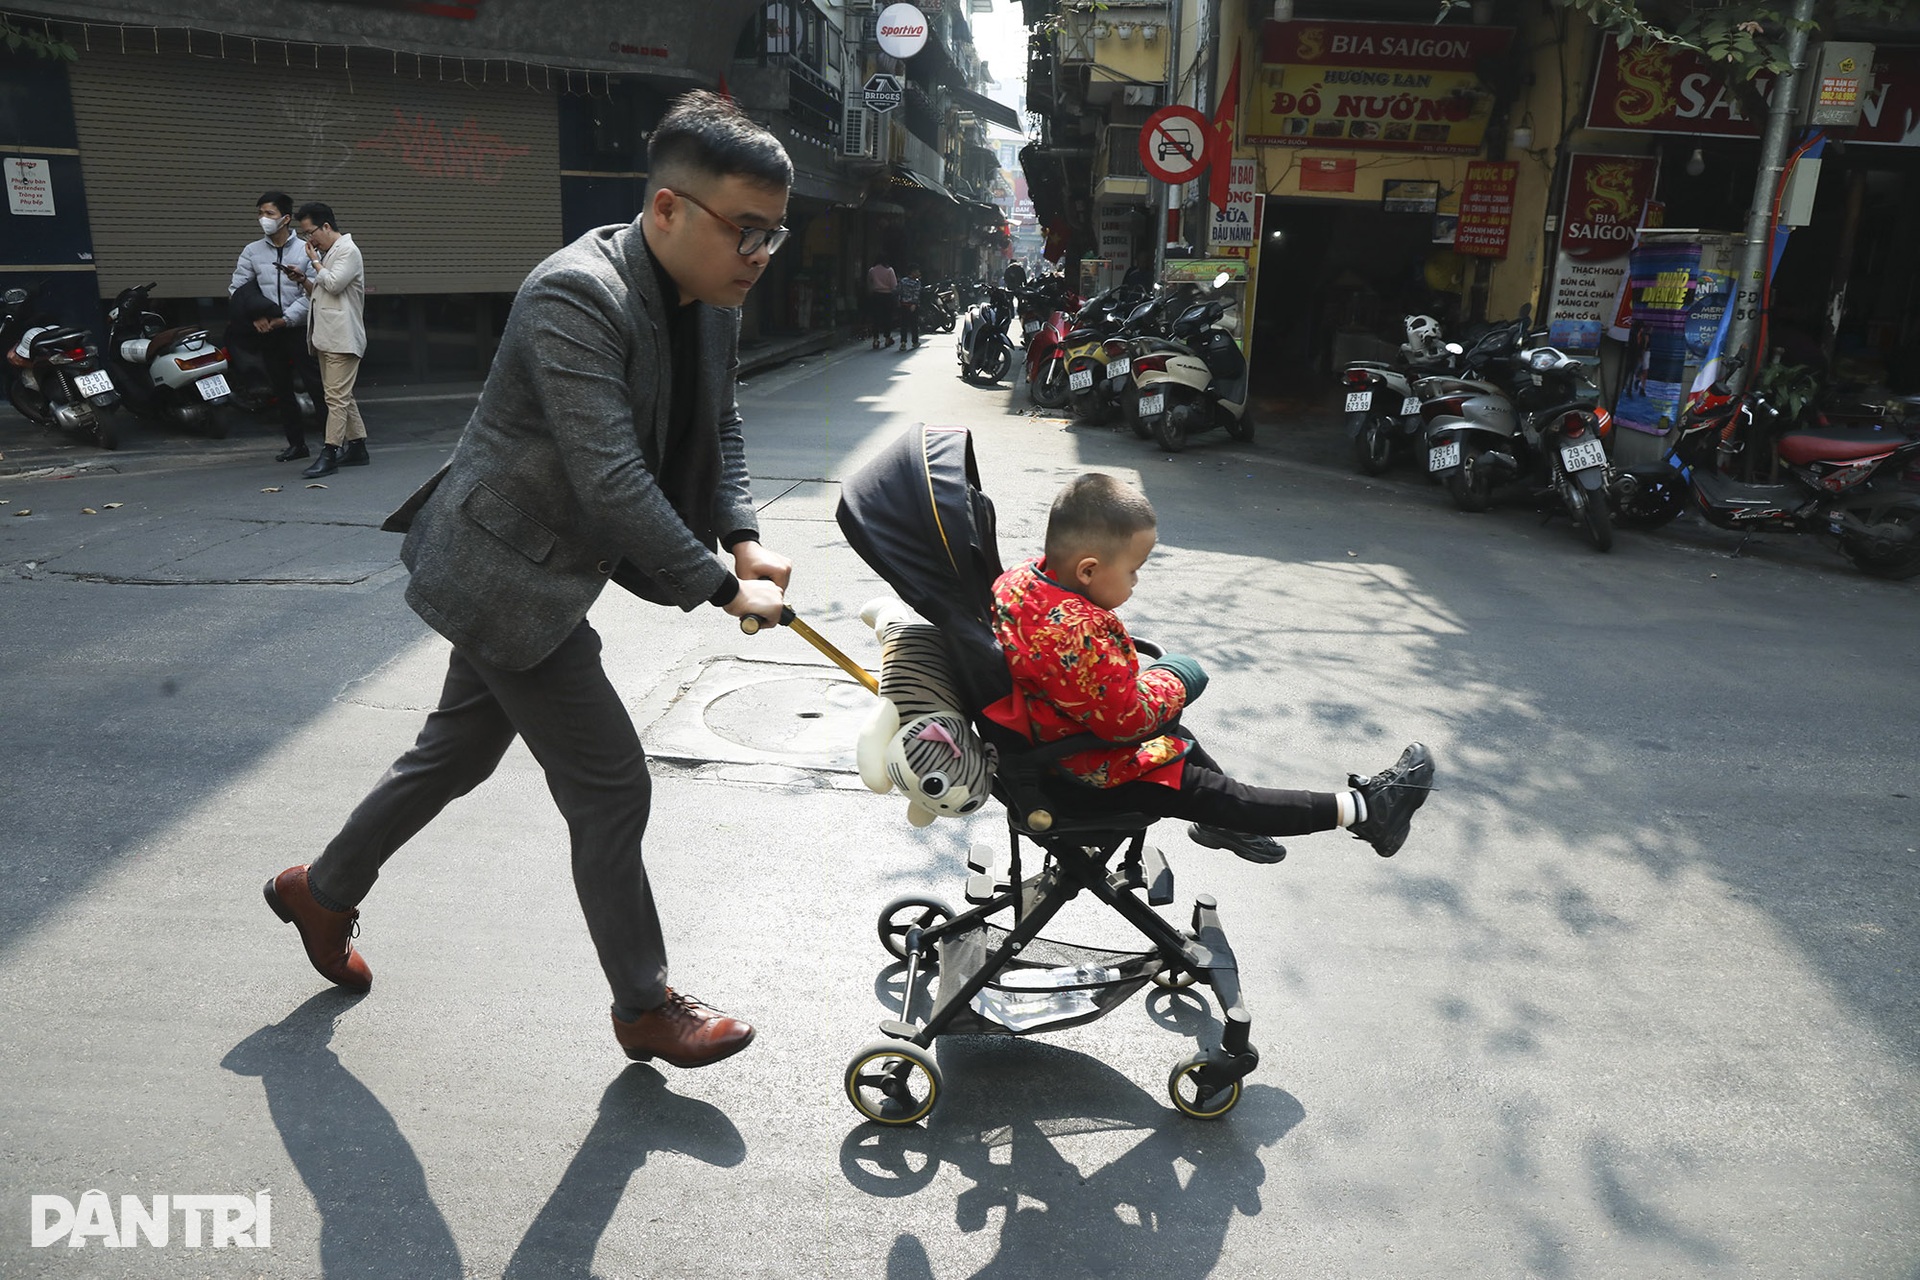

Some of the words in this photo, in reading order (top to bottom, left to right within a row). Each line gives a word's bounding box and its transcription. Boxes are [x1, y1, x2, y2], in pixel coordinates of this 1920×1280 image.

[1331, 35, 1374, 55] BIA
[1380, 36, 1470, 59] SAIGON
[1392, 73, 1432, 88] LAN
[864, 92, 901, 101] BRIDGES
[1270, 82, 1323, 116] ĐỒ
[1238, 165, 1254, 185] BAO
[1594, 213, 1617, 224] BIA
[1568, 222, 1636, 241] SAIGON
[1572, 266, 1600, 276] THẠCH
[1561, 278, 1578, 286] BÚN
[1695, 283, 1719, 294] ANTA
[1559, 289, 1576, 297] BÚN
[1577, 289, 1589, 298] CÁ
[80, 372, 105, 387] 29-B1
[82, 380, 112, 396] 295.62
[1433, 445, 1455, 459] 29-E1
[1567, 443, 1597, 459] 29-C1
[1431, 454, 1458, 470] 733.70
[1567, 452, 1603, 470] 308.38
